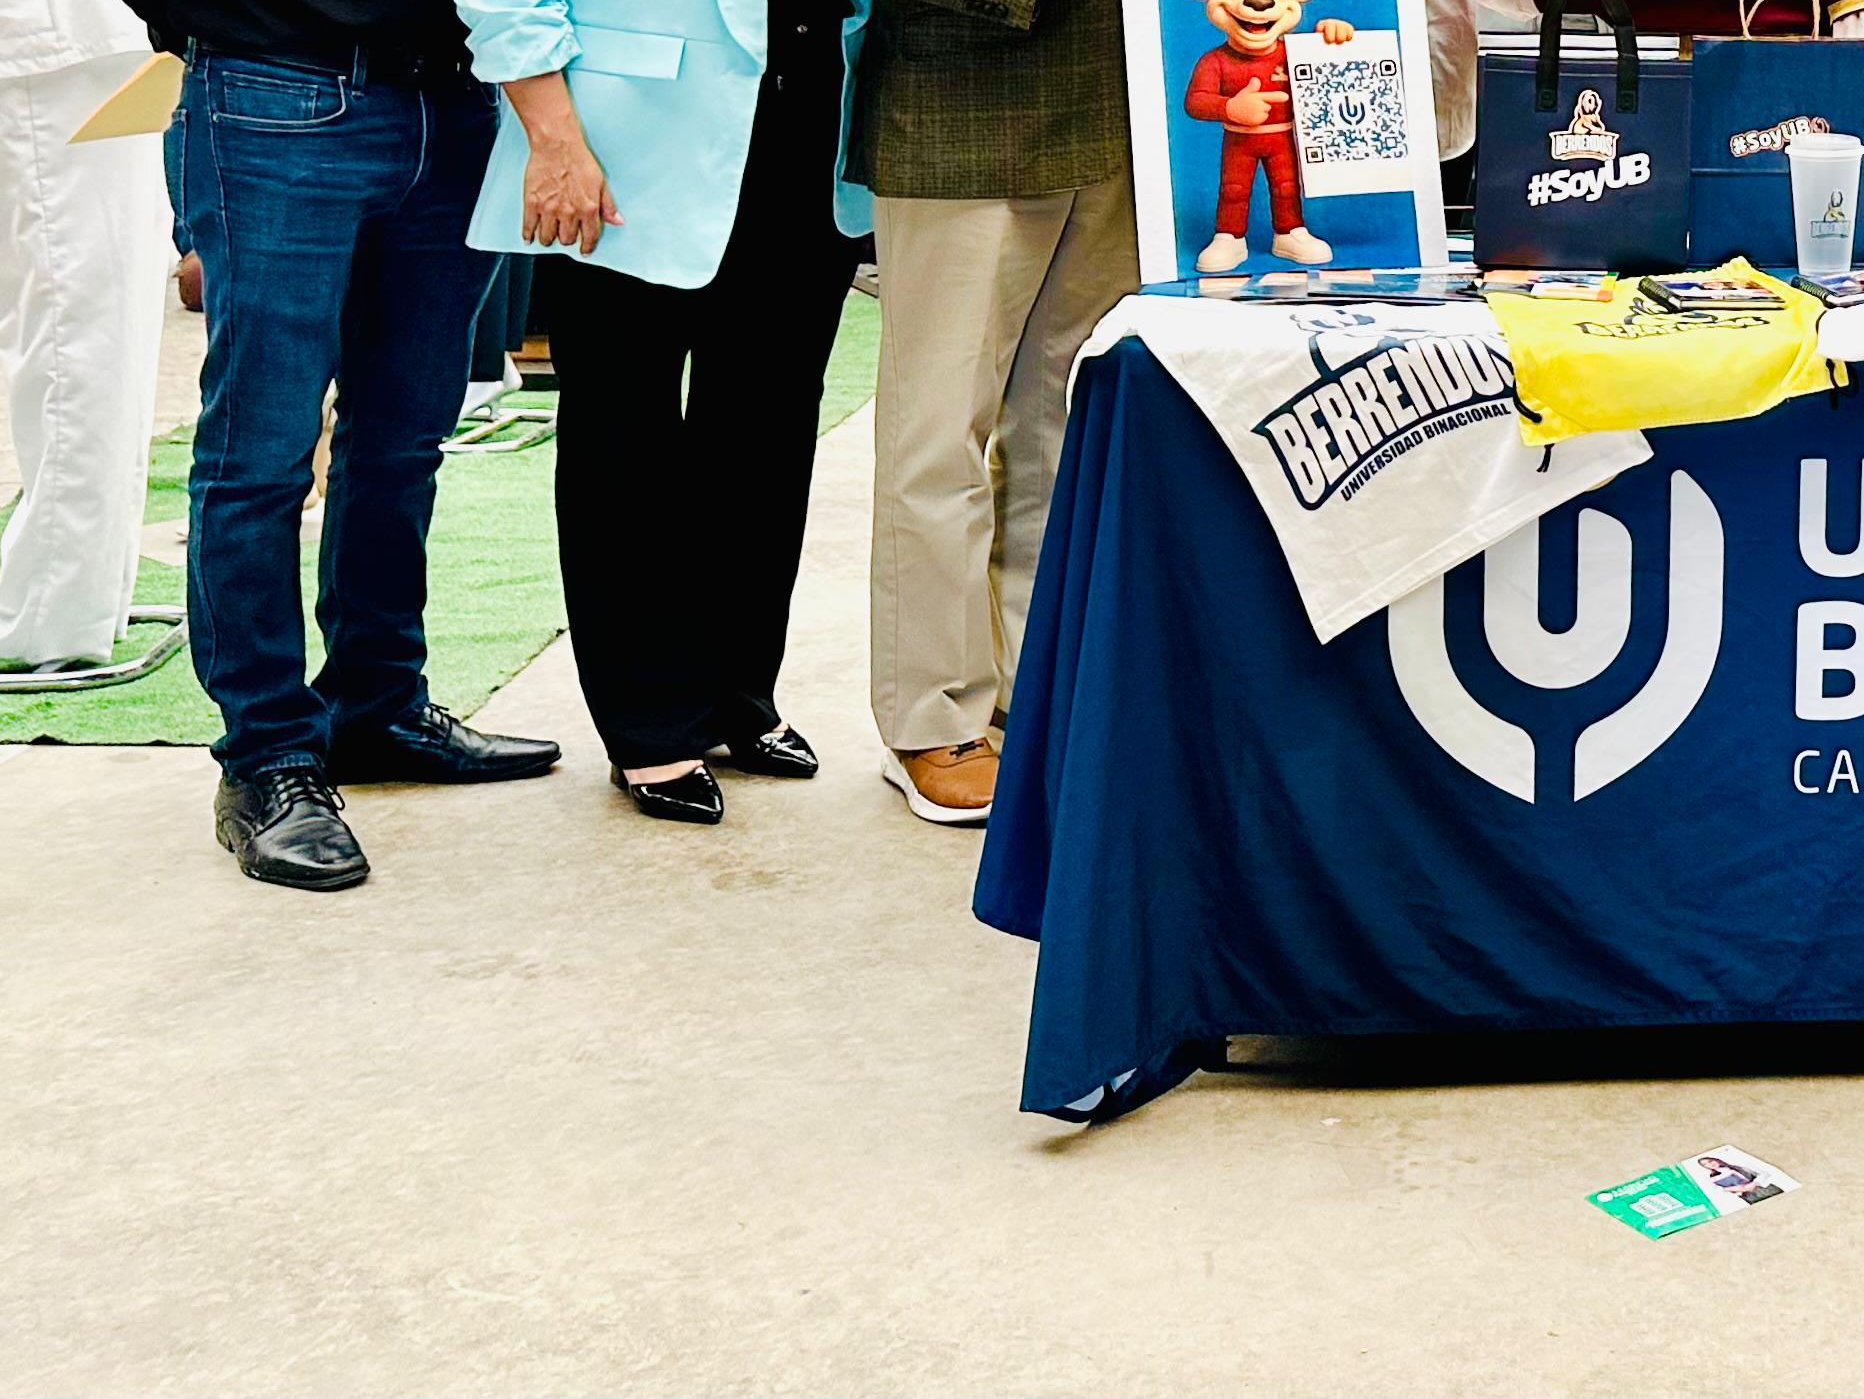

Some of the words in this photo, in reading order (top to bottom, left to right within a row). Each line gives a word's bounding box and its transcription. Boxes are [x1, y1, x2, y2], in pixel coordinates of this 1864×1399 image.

[1732, 117, 1811, 155] #SoyUB
[1527, 152, 1651, 207] #SoyUB
[1341, 431, 1423, 502] UNIVERSIDAD
[1425, 403, 1512, 440] BINACIONAL
